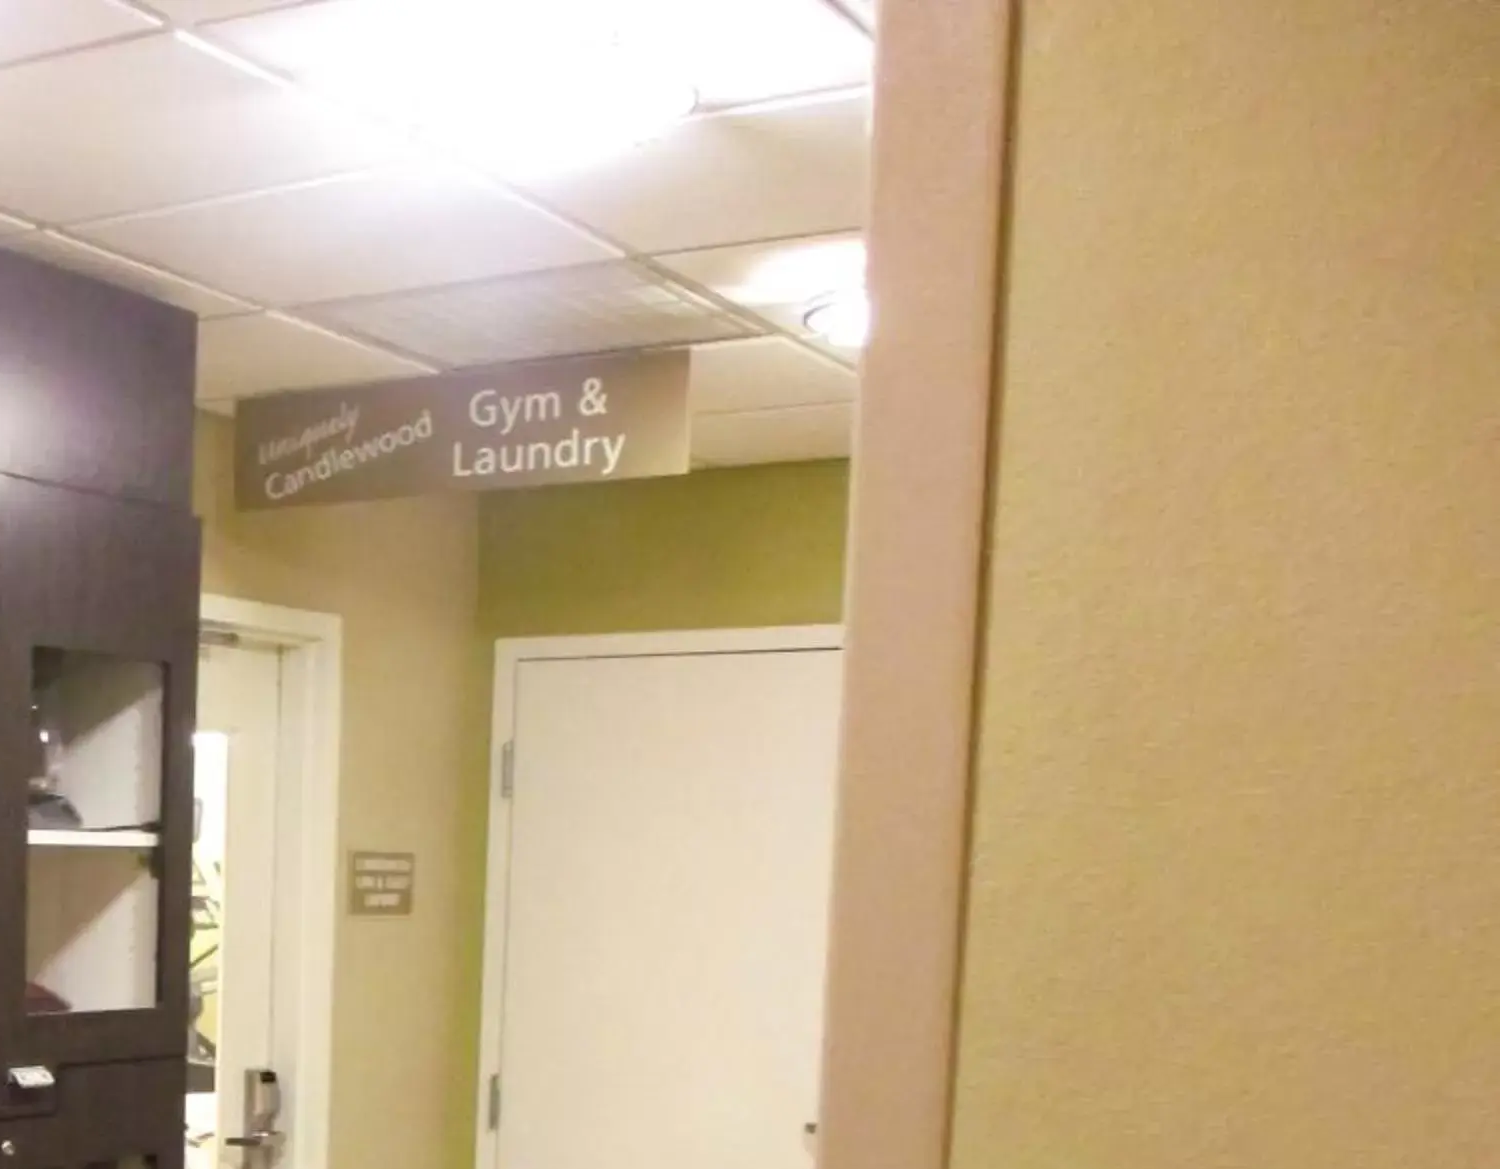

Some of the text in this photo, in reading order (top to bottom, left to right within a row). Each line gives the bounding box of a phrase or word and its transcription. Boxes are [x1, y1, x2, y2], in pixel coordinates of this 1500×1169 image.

[469, 377, 607, 436] Gym &
[265, 409, 433, 500] Candlewood
[452, 427, 626, 477] Laundry
